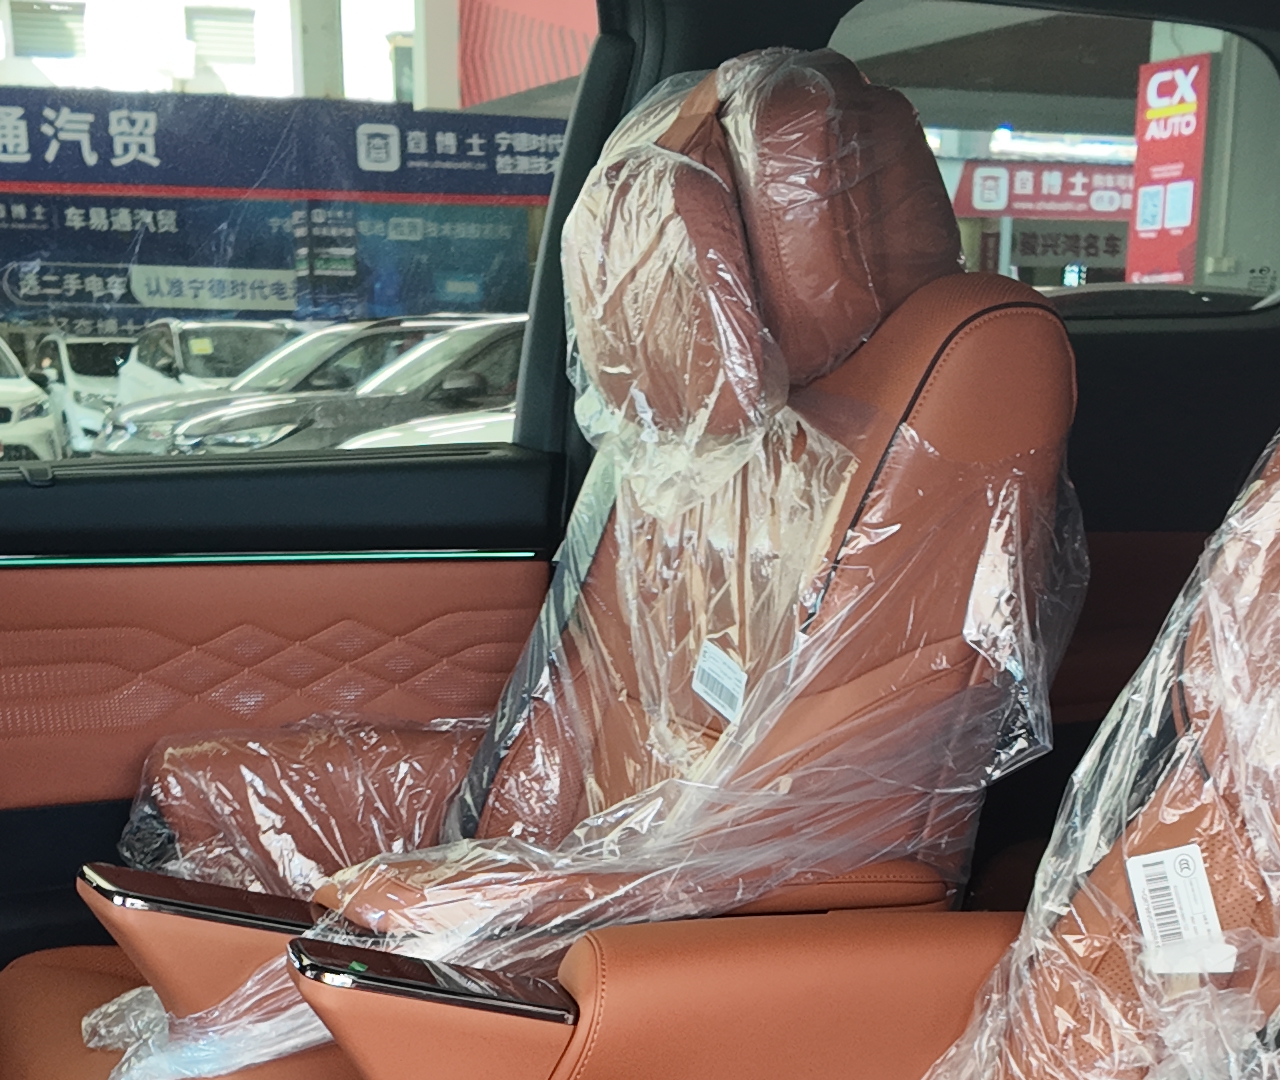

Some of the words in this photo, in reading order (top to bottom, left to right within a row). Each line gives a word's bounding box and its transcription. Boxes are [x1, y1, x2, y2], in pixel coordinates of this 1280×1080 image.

[1147, 64, 1199, 108] CX
[1144, 114, 1196, 140] AUTO
[64, 206, 179, 233] 车易通汽贸
[145, 278, 297, 300] 认准宁德时代电
